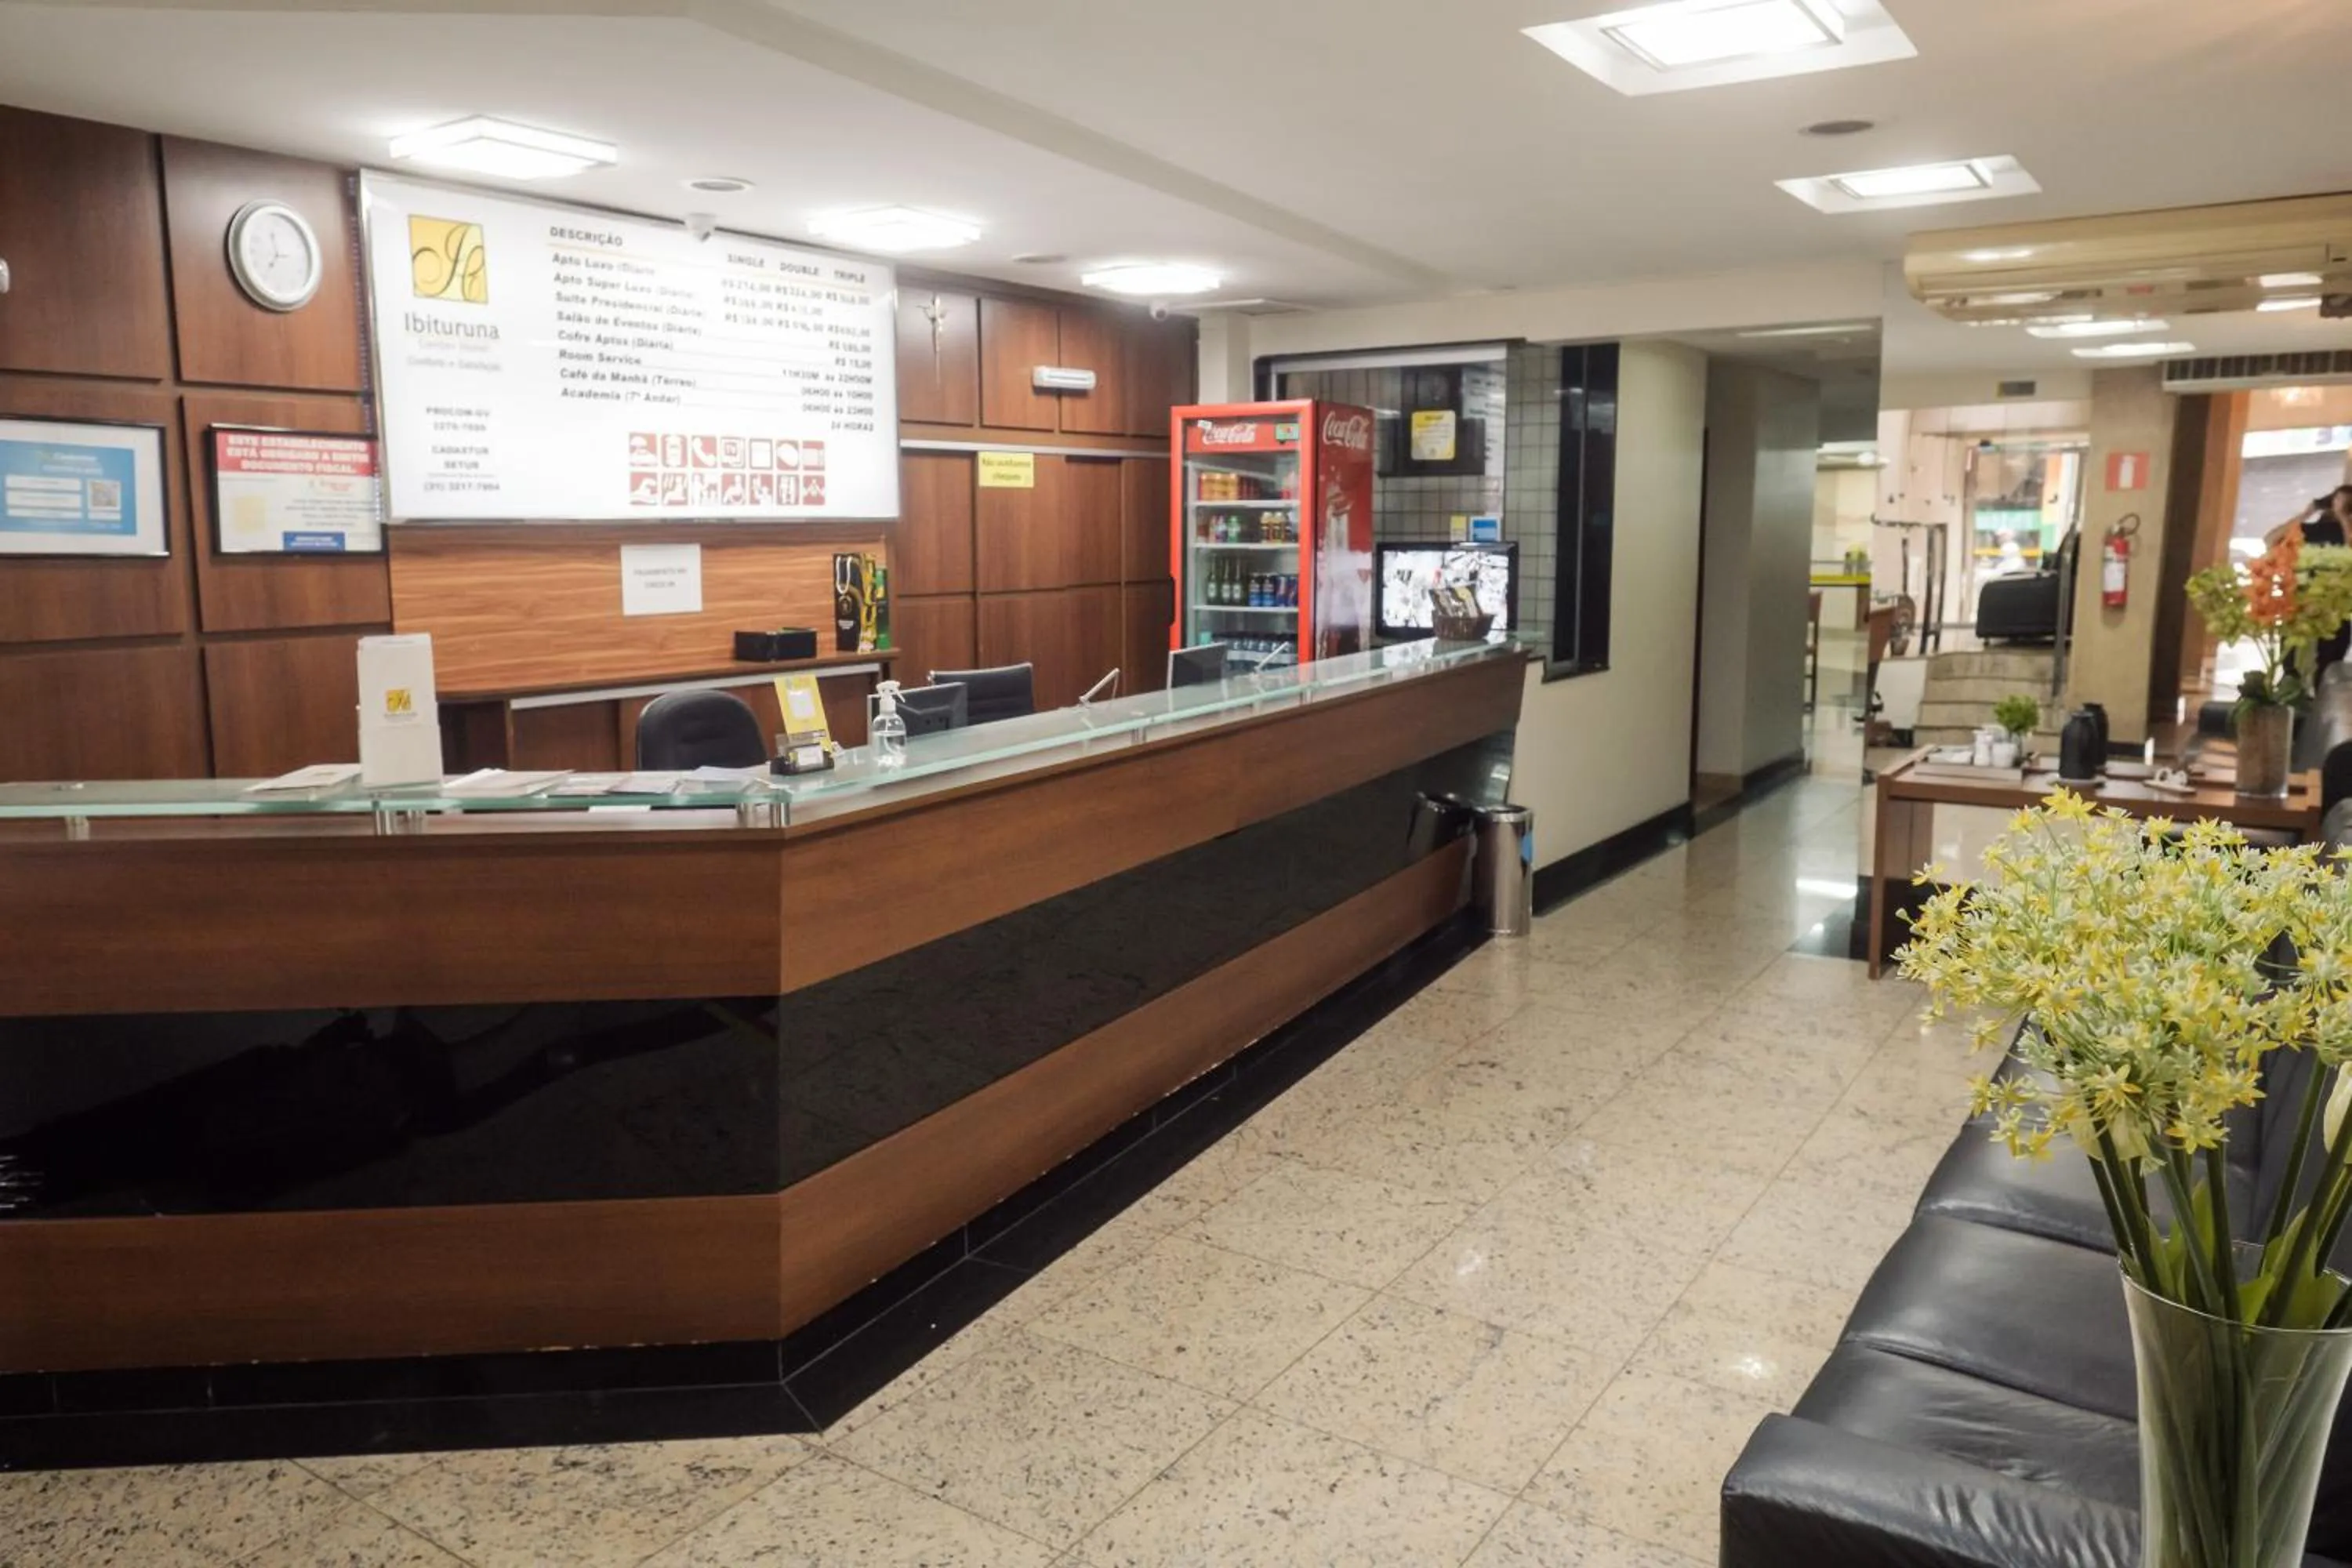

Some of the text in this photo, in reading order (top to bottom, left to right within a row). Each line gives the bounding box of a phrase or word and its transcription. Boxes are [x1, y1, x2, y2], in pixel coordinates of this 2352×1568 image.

[550, 226, 866, 284] DESCRIÇÃO SINGLE DOUBLE TRIPLE
[552, 252, 581, 267] Apto
[585, 257, 614, 270] Luxo
[554, 271, 583, 285] Apto
[586, 276, 621, 290] Super
[624, 281, 652, 293] Luxo
[591, 296, 663, 312] Presidencial
[404, 311, 500, 339] Ibituruna
[557, 310, 590, 324] Salão
[595, 314, 609, 325] de
[613, 317, 659, 331] Eventos
[557, 329, 590, 343] Cofre
[595, 333, 629, 347] Aptos
[559, 349, 593, 361] Room
[598, 352, 642, 365] Service
[559, 367, 589, 379] Café
[592, 371, 606, 381] da
[611, 372, 648, 384] Manhã
[561, 387, 621, 401] Academia
[644, 392, 681, 407] Andar)
[321, 451, 330, 461] A
